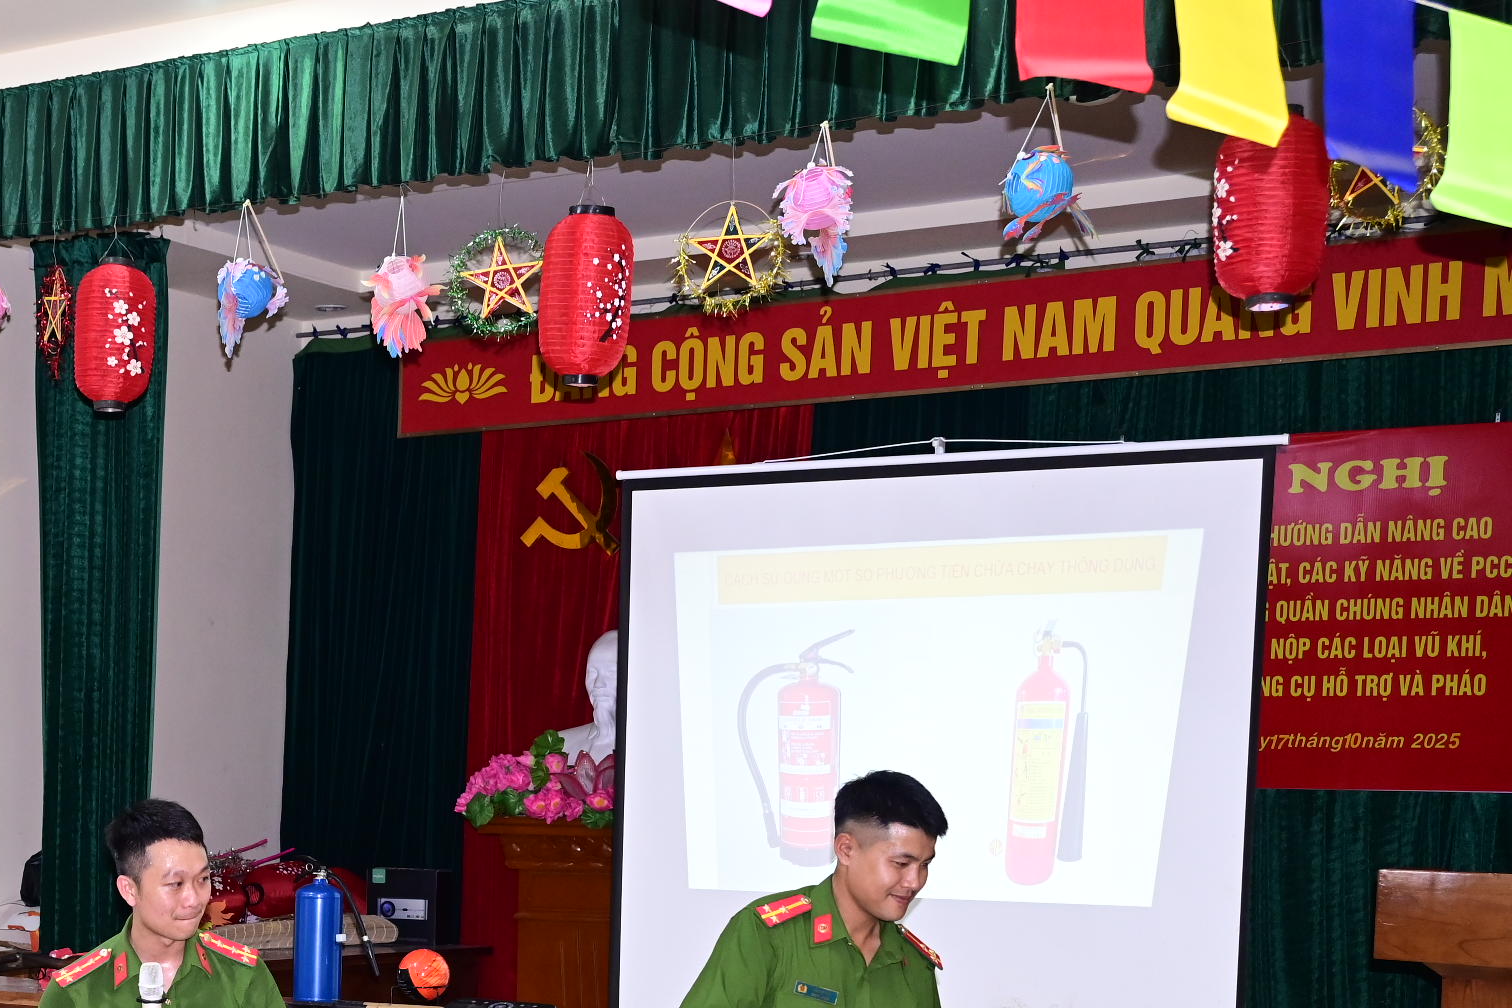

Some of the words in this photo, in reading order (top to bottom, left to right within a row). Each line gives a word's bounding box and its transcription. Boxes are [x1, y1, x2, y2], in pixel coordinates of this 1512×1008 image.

[651, 326, 766, 401] CỘNG
[780, 306, 874, 382] SẢN
[889, 300, 987, 379] VIỆT
[1001, 295, 1118, 362] NAM
[1331, 260, 1462, 332] VINH
[1288, 455, 1449, 497] NGHỊ
[1339, 513, 1381, 545] DẪN
[1387, 515, 1445, 543] NÂNG
[1452, 516, 1494, 541] CAO
[1298, 556, 1337, 584] CÁC
[1343, 556, 1370, 583] KỸ
[1375, 555, 1433, 582] NĂNG
[1439, 549, 1465, 580] VỀ
[1275, 592, 1329, 624] QUẦN
[1335, 594, 1404, 621] CHÚNG
[1409, 591, 1469, 619] NHÂN
[1270, 633, 1311, 664] NỘP
[1317, 632, 1357, 659] CÁC
[1363, 635, 1408, 663] LOẠI
[1414, 631, 1439, 658] VŨ
[1446, 630, 1488, 660] KHÍ,
[1290, 675, 1316, 702] CỤ
[1322, 667, 1348, 697] HỖ
[1355, 672, 1393, 702] TRỢ
[1399, 670, 1424, 697] VÀ
[1431, 669, 1488, 697] PHÁO
[1410, 732, 1461, 750] 2025
